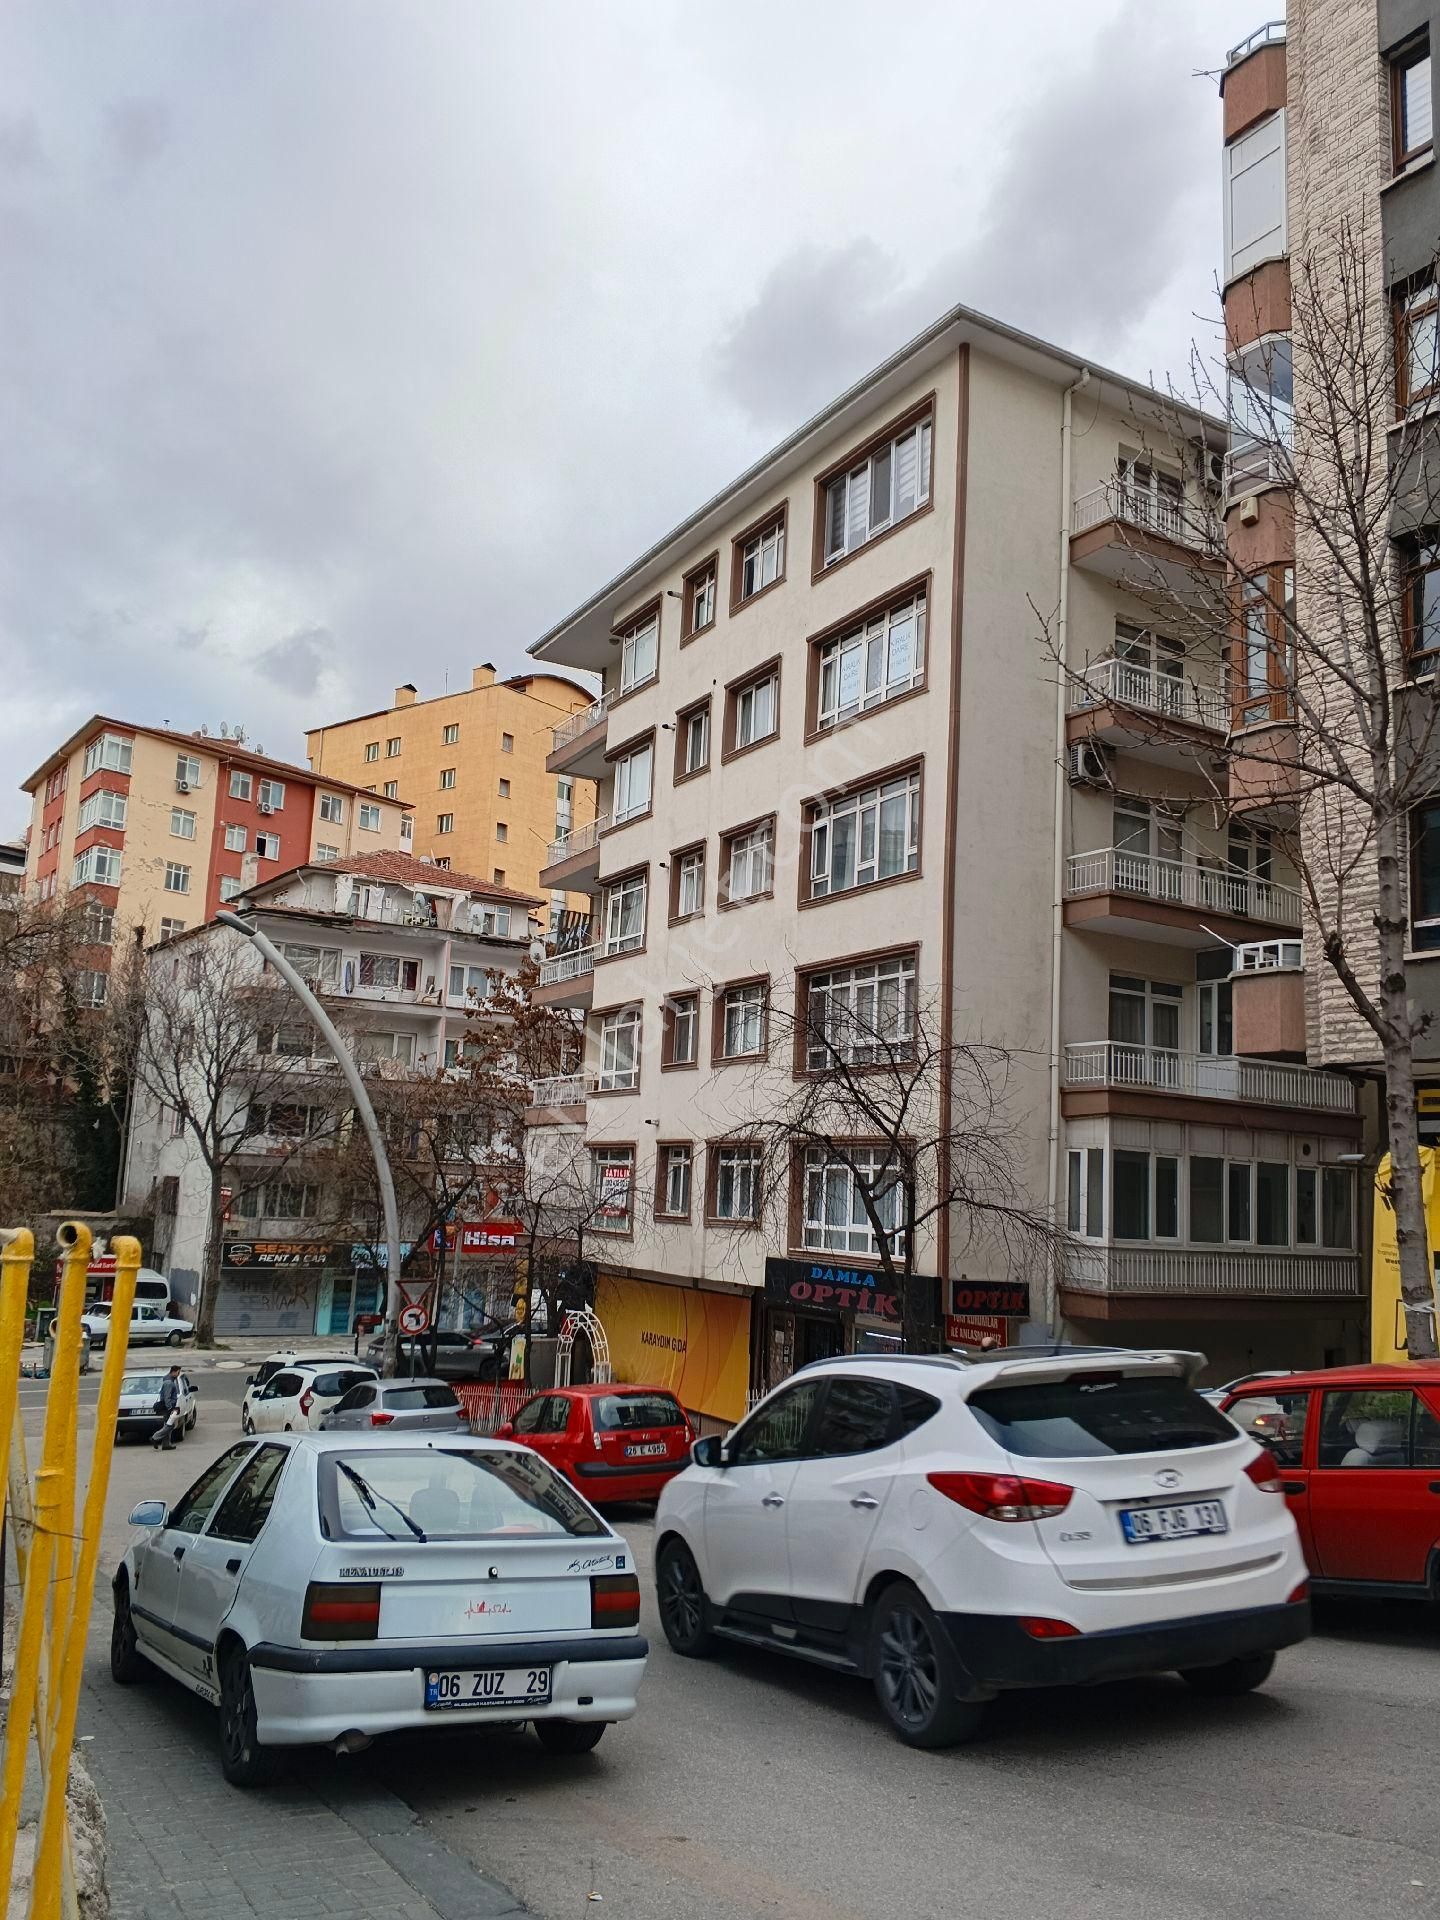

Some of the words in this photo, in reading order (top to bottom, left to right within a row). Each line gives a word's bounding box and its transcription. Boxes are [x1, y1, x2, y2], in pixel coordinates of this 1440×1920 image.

[254, 1244, 333, 1254] SERKAN
[258, 1254, 286, 1262] RENT
[291, 1254, 300, 1262] A
[303, 1254, 327, 1263] CAR
[811, 1267, 876, 1287] DAMLA
[790, 1281, 899, 1316] OPTİK
[339, 1567, 388, 1578] RENAULT
[439, 1674, 461, 1698] 06
[472, 1672, 505, 1696] ZUZ
[526, 1670, 548, 1694] 29
